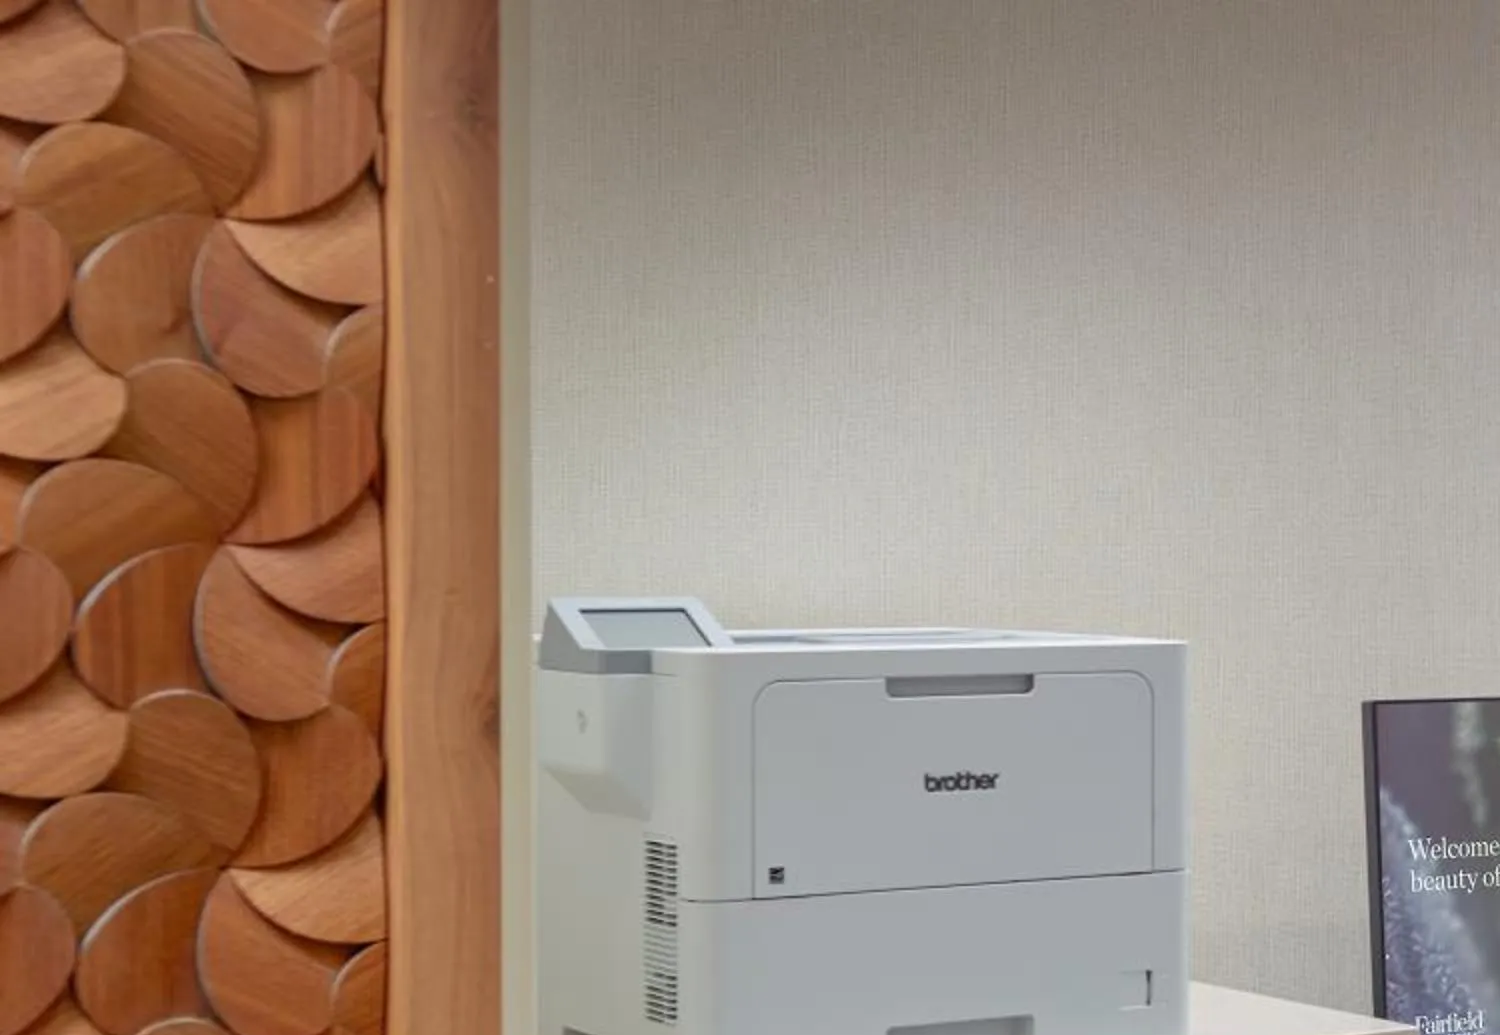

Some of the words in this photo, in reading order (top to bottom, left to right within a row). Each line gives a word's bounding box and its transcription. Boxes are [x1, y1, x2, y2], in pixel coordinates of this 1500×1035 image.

[924, 771, 1000, 792] brother
[1408, 836, 1500, 861] Welcome
[1410, 868, 1478, 894] beauty
[1415, 1010, 1484, 1035] Fairfield
